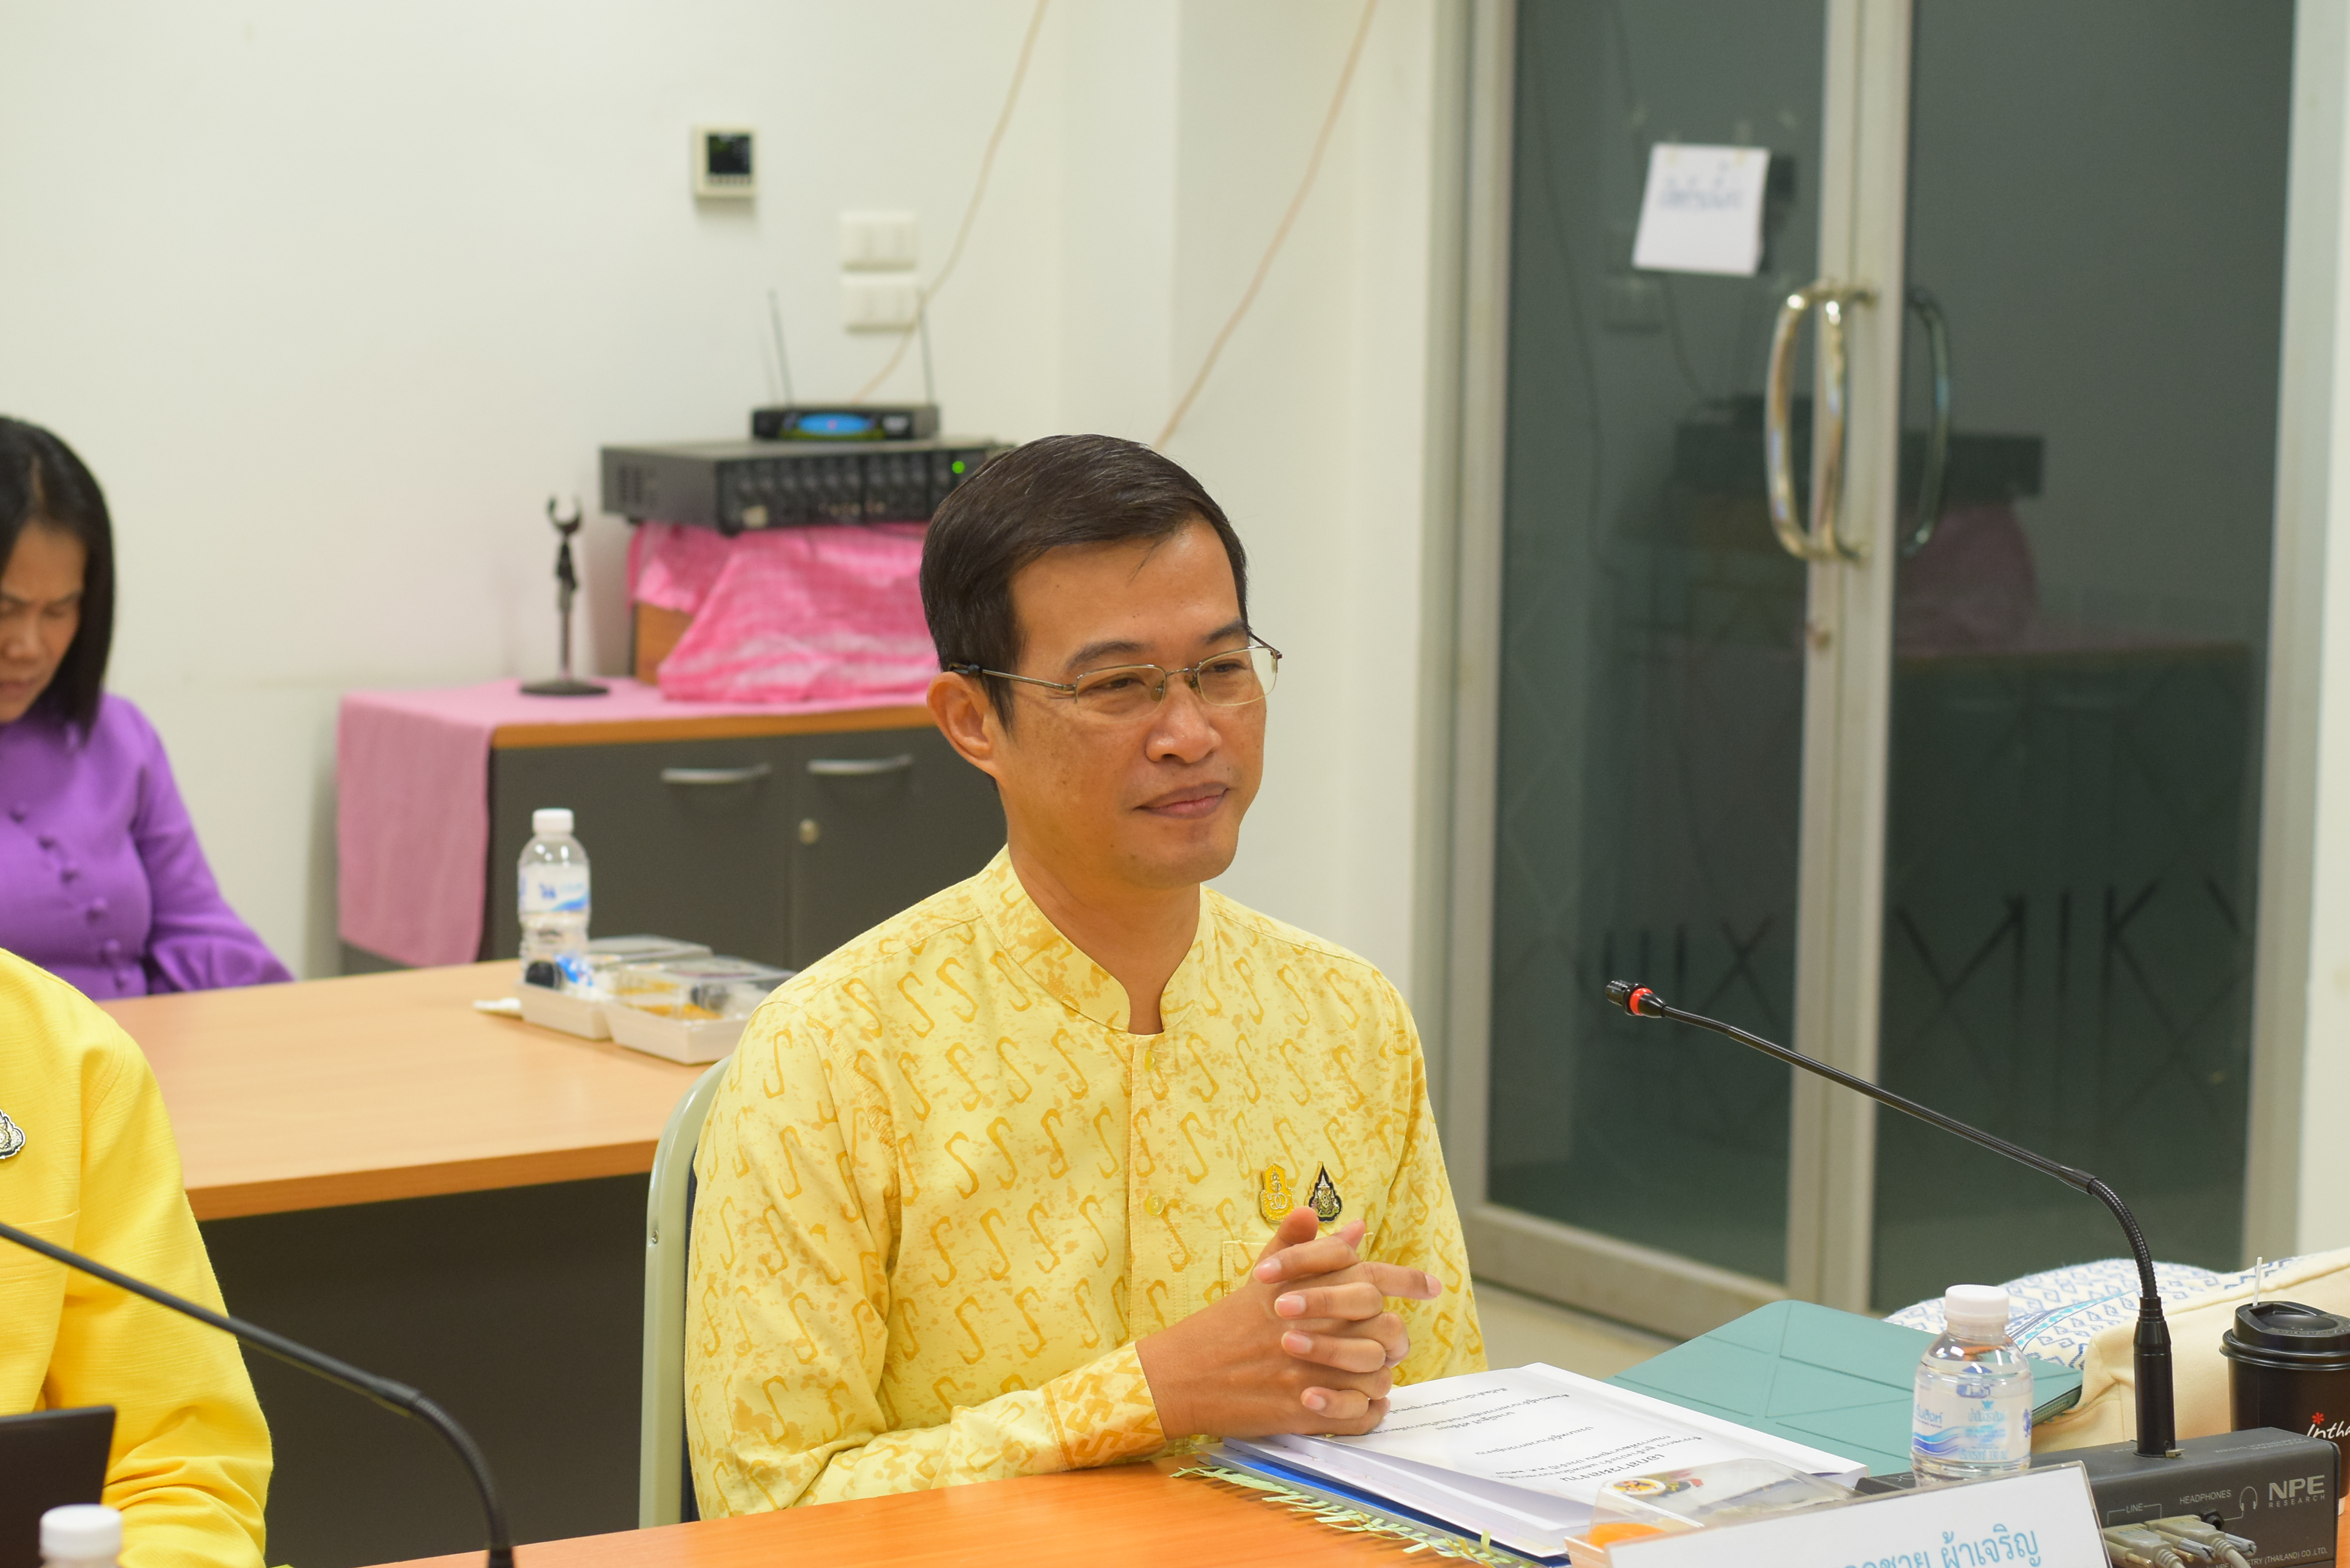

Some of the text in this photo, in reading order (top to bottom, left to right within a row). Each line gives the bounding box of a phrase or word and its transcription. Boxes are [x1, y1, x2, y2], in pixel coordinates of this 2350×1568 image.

[1560, 1454, 1665, 1482] เอกสารผลงาน
[2269, 1475, 2325, 1501] NPE
[2180, 1490, 2231, 1505] HEADPHONES
[2268, 1494, 2325, 1508] RESEARCH
[2126, 1503, 2143, 1513] LINE
[1940, 1523, 2041, 1568] ผ้าเจริญ
[2264, 1552, 2300, 1565] (THAILAND)
